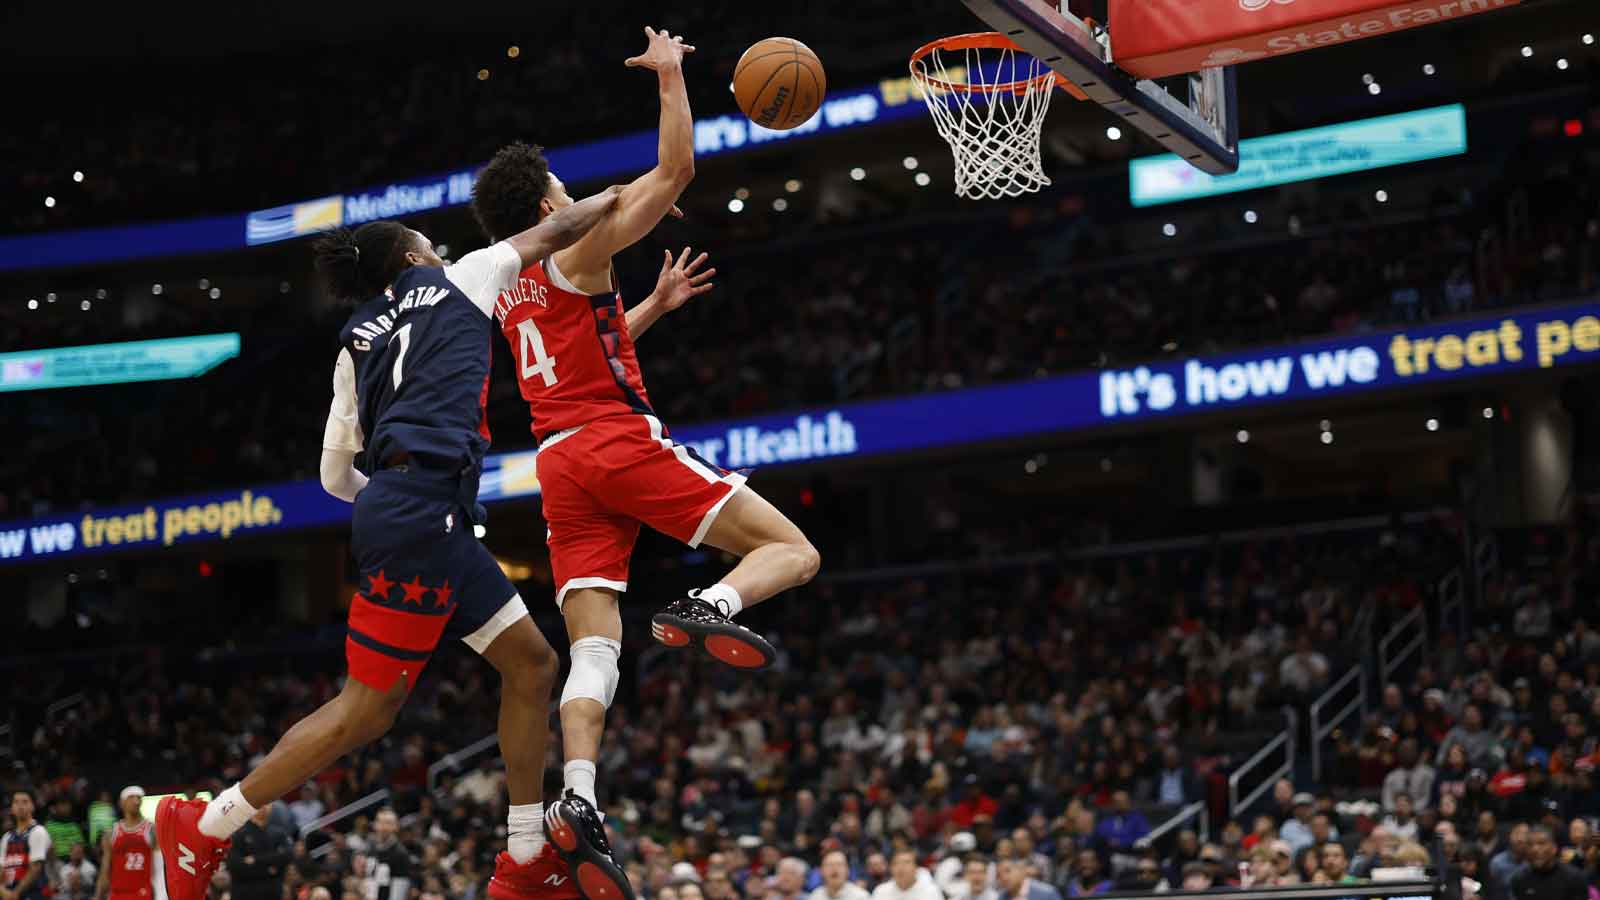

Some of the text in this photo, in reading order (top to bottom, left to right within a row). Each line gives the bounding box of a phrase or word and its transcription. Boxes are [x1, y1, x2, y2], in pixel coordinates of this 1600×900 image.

[1267, 19, 1385, 51] State
[516, 318, 558, 387] 4
[1100, 367, 1176, 416] It's
[1184, 357, 1293, 405] how
[1300, 346, 1380, 389] we
[1389, 319, 1524, 376] treat
[727, 411, 857, 469] Health
[31, 522, 75, 554] we
[81, 506, 157, 548] treat
[163, 489, 282, 546] people.
[125, 852, 145, 870] 22
